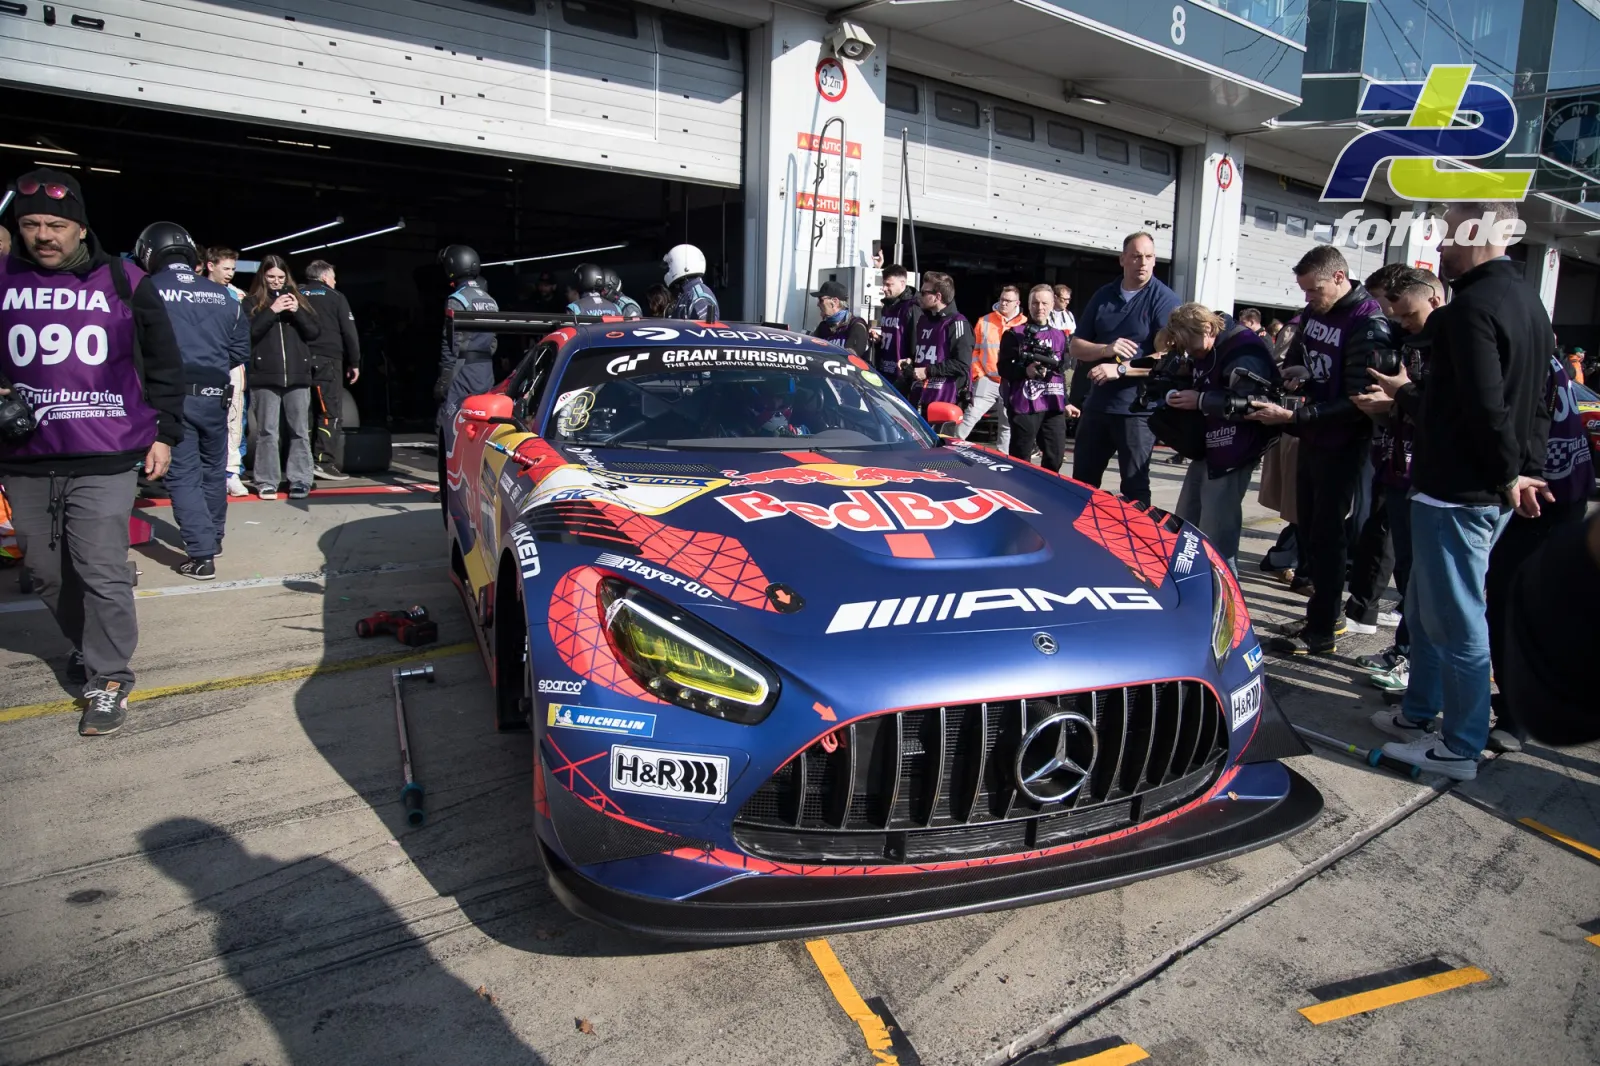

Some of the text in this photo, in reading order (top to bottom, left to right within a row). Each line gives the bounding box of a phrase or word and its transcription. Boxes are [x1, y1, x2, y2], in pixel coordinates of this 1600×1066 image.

[1170, 5, 1186, 45] 8
[807, 197, 850, 213] ACHTUG
[2, 287, 111, 312] MEDIA
[1303, 317, 1342, 347] MEDIA
[8, 323, 109, 367] 090
[662, 349, 807, 366] GRAN TURISMO
[757, 361, 809, 371] SIMULATOR
[34, 388, 124, 406] nürburgring
[48, 411, 105, 420] LANGSTRECKEN
[562, 390, 596, 432] 3
[616, 556, 686, 586] Player
[538, 679, 582, 693] sparco
[576, 714, 645, 731] MICHELIN
[615, 753, 684, 791] H&R
